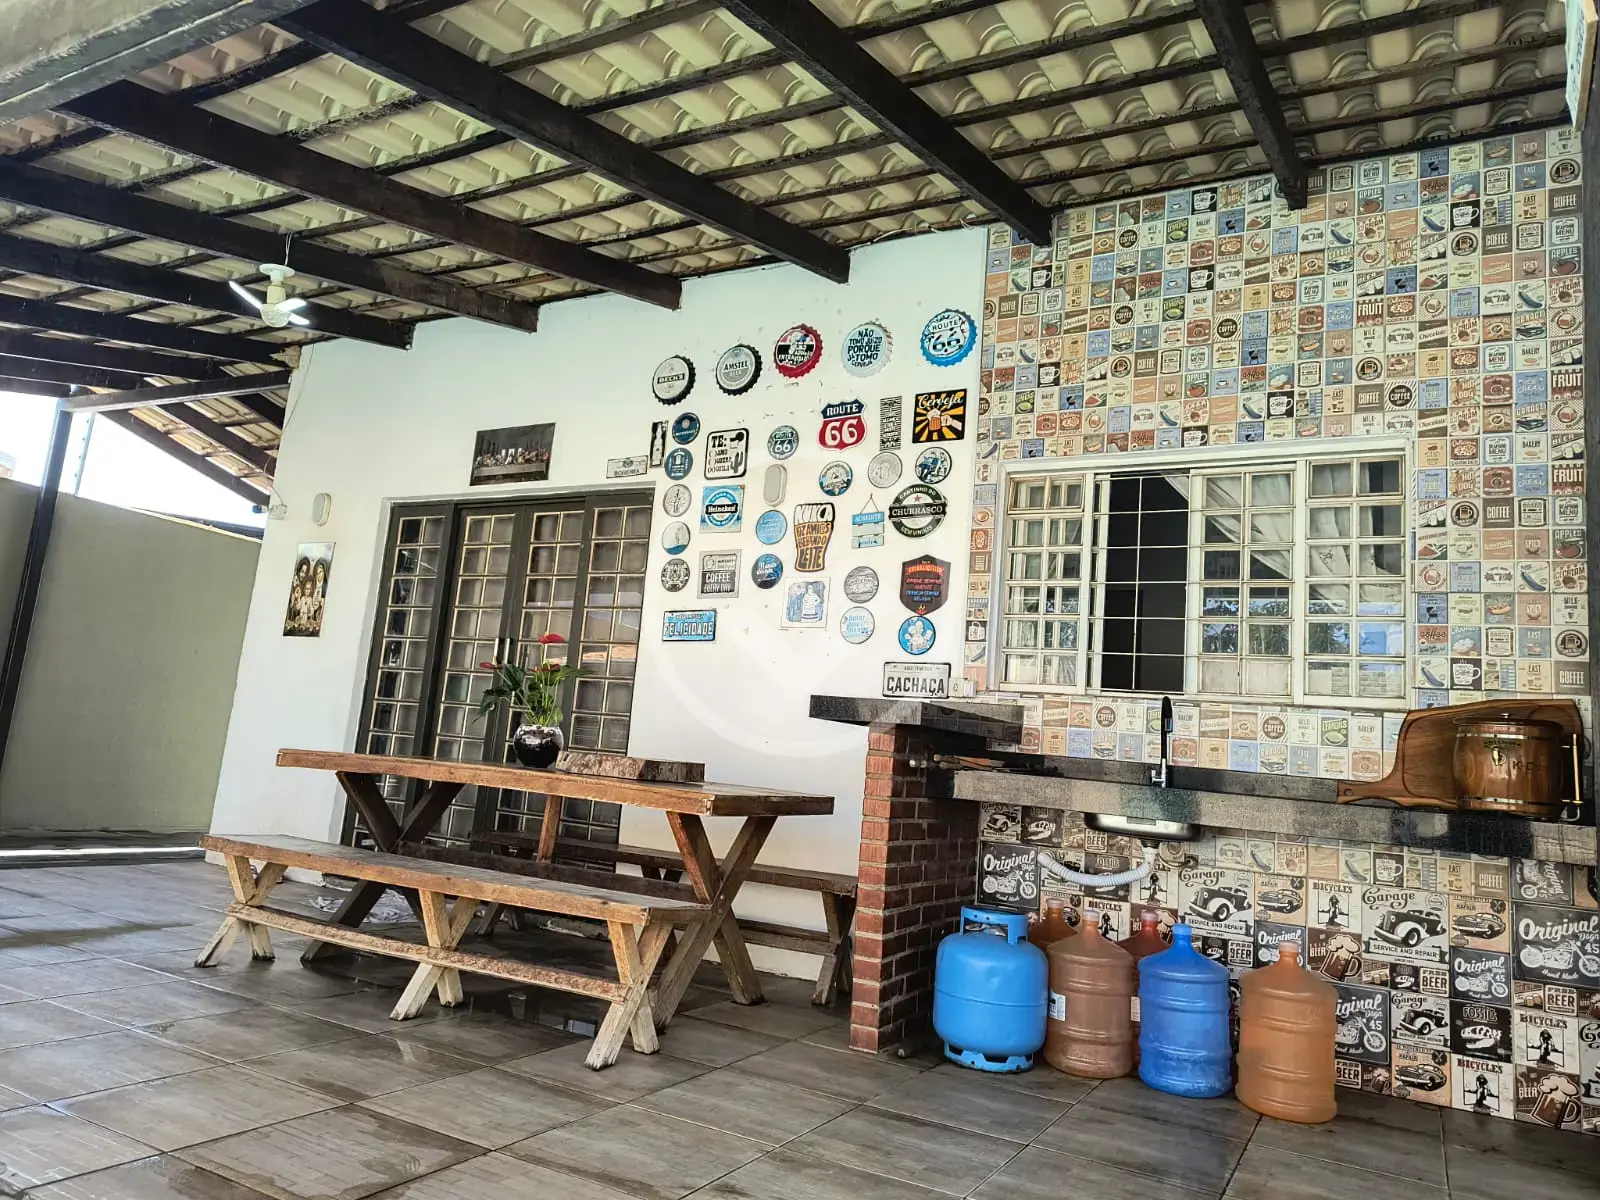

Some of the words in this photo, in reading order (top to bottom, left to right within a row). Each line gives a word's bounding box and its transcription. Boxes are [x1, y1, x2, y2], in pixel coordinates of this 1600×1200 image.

[1554, 194, 1577, 209] COFFEE
[1486, 233, 1508, 247] COFFEE
[1552, 248, 1578, 259] APPLES
[1358, 303, 1383, 317] FRUIT
[932, 320, 960, 331] ROUTE
[858, 328, 874, 338] NÃO
[848, 338, 866, 346] TOMO
[932, 331, 962, 351] 66
[847, 344, 881, 355] PORQUE
[1522, 348, 1540, 356] BAKERY
[855, 352, 879, 362] TOMO
[724, 360, 749, 372] AMSTEL
[1552, 374, 1583, 388] FRUIT
[918, 394, 964, 410] Cerveja
[1359, 391, 1381, 405] COFFEE
[826, 403, 859, 417] ROUTE
[824, 419, 859, 446] 66
[711, 435, 727, 448] TE:
[774, 440, 791, 453] 66
[1522, 440, 1541, 449] BAKERY
[1553, 468, 1584, 483] FRUIT
[708, 504, 737, 513] Heineken
[891, 504, 943, 516] CHURRASCO
[1486, 506, 1510, 519] COFFEE
[1554, 530, 1583, 541] APPLES
[798, 546, 824, 569] LEITE
[705, 573, 731, 583] COFFEE
[1563, 597, 1578, 605] MILK
[1559, 671, 1585, 685] COFFEE
[1087, 836, 1107, 847] BEER
[983, 850, 1035, 872] Original
[1025, 872, 1035, 882] 45
[1178, 867, 1226, 888] Garage
[1479, 873, 1504, 889] COFFEE
[1312, 882, 1353, 894] BICYCLES
[1362, 887, 1416, 909] Garage
[1088, 900, 1122, 912] BICYCLES
[1187, 917, 1211, 930] SERVICE
[1211, 920, 1224, 930] AND
[1223, 922, 1245, 931] REPAIR
[1518, 915, 1600, 943] Original
[1258, 928, 1301, 945] Original
[1230, 947, 1252, 961] BEER
[1309, 942, 1327, 958] BEER
[1373, 944, 1400, 953] SERVICE
[1399, 947, 1413, 955] AND
[1413, 949, 1438, 958] REPAIR
[1583, 942, 1600, 954] 45
[1454, 956, 1505, 973] Original
[1422, 975, 1448, 989] BEER
[1495, 974, 1505, 982] 45
[1335, 993, 1382, 1019] iginal
[1391, 992, 1428, 1009] Garage
[1547, 993, 1576, 1007] BEER
[1462, 1005, 1498, 1022] FOSSILS
[1369, 1020, 1383, 1031] 45
[1519, 1013, 1568, 1029] BICYCLES
[1336, 1066, 1360, 1080] BEER
[1456, 1058, 1504, 1074] BICYCLES
[1518, 1086, 1538, 1099] BEER
